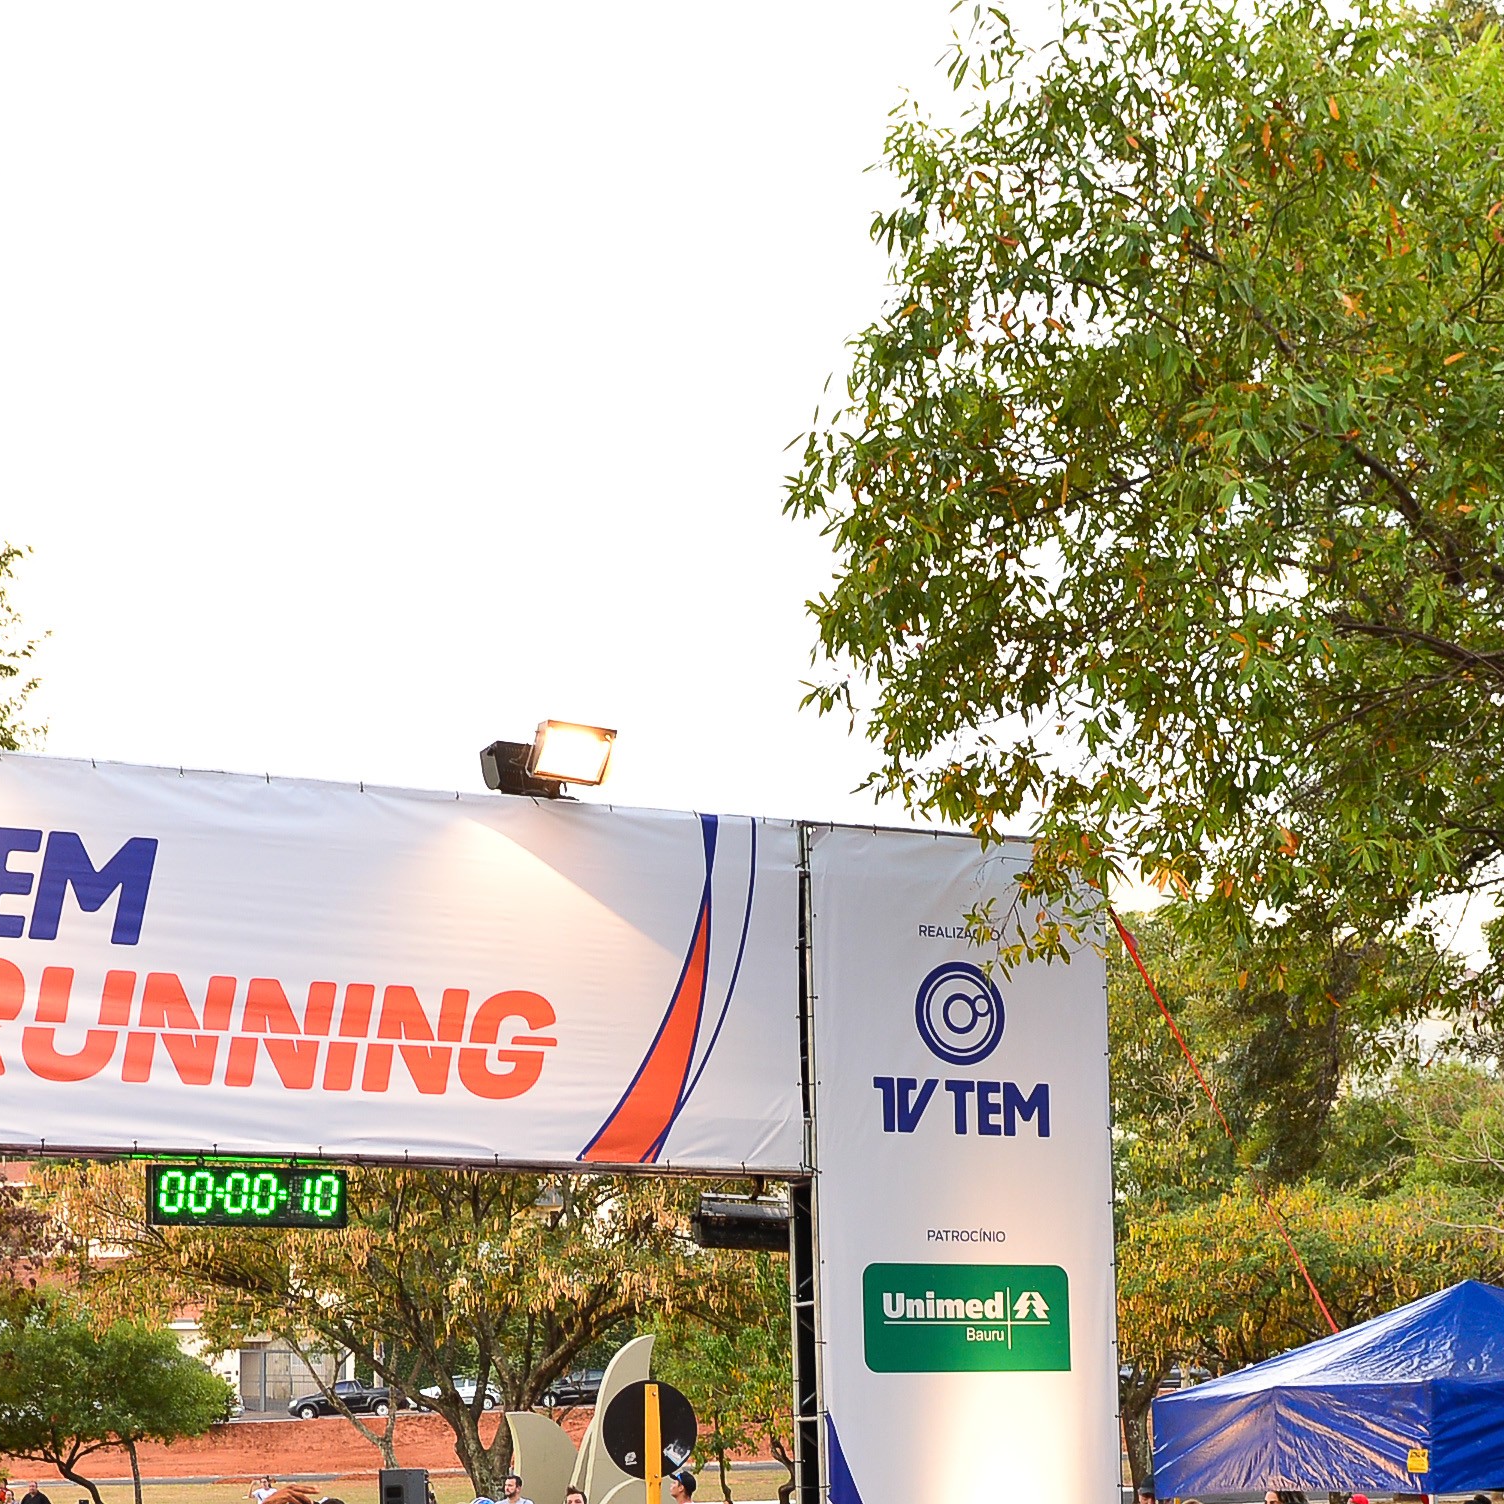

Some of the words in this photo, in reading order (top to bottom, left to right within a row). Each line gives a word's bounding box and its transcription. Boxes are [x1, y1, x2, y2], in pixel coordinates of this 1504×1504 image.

[872, 1076, 940, 1134] TV
[944, 1080, 1051, 1138] TEM
[926, 1226, 1006, 1244] PATROCÍNIO
[881, 1290, 1004, 1320] Unimed
[965, 1326, 1005, 1343] Bauru
